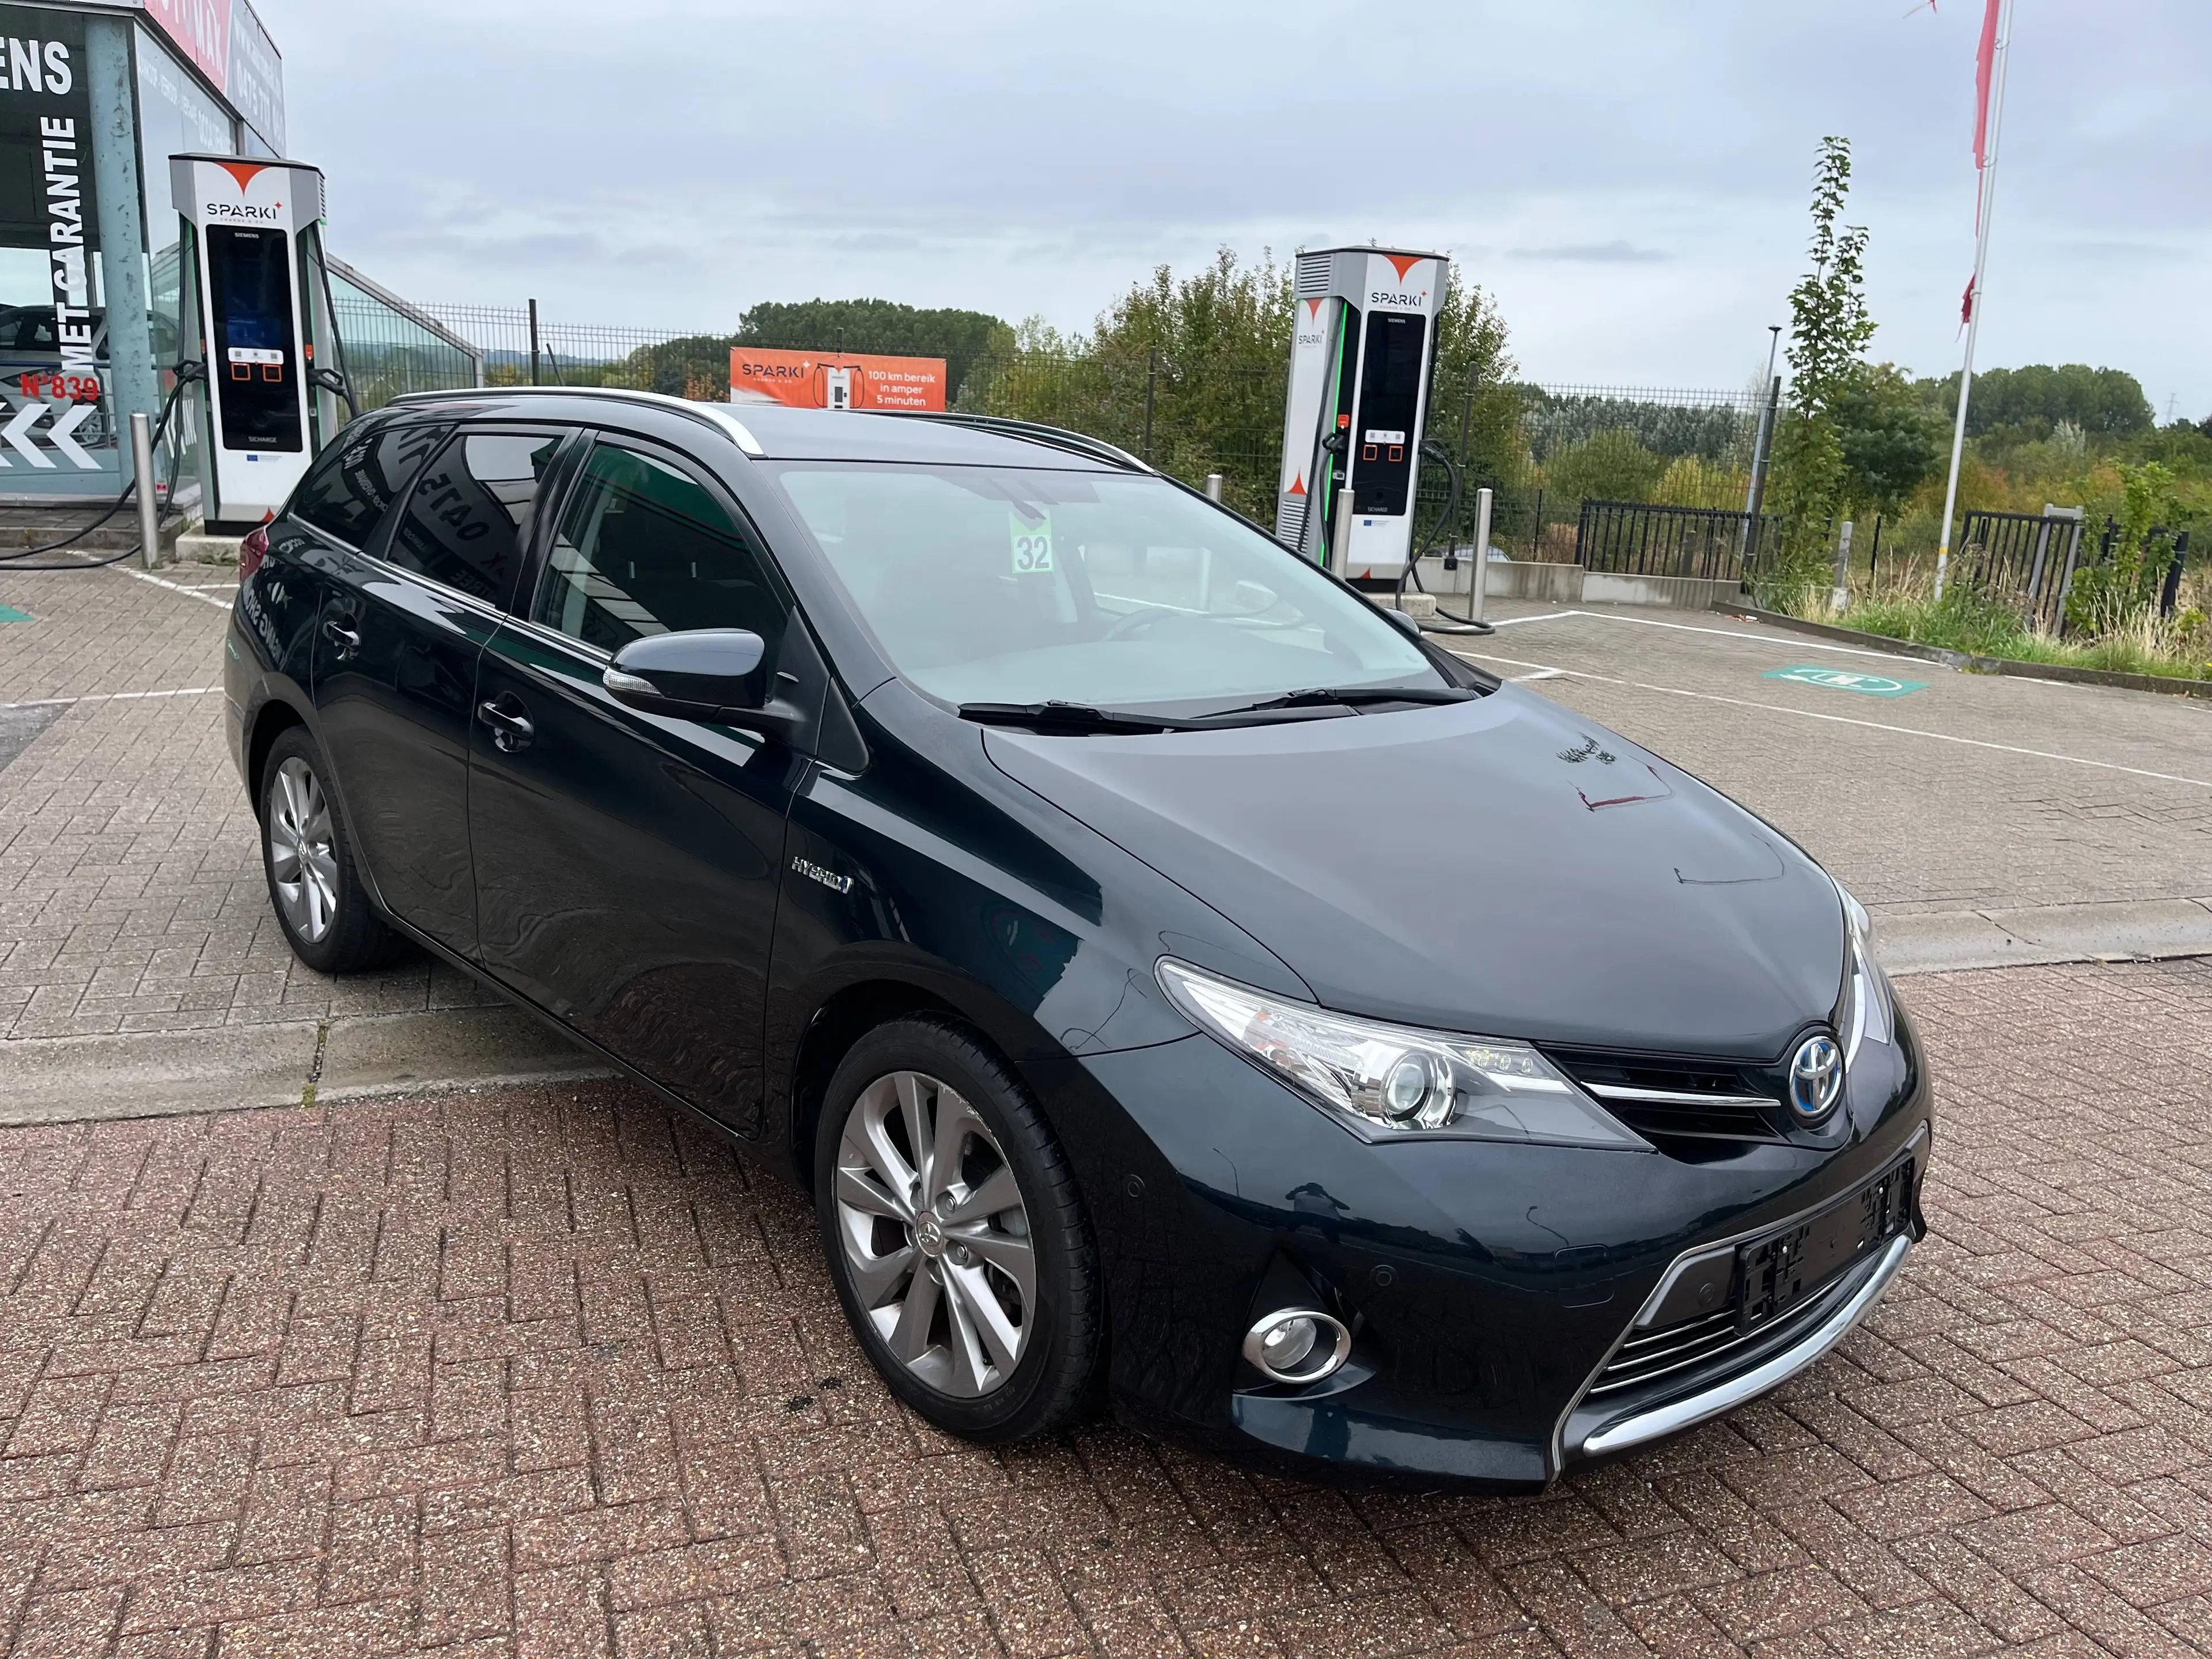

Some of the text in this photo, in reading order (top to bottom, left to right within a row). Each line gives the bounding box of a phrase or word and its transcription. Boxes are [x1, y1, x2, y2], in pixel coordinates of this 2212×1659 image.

[0, 36, 73, 95] NS
[207, 203, 276, 219] SPARKI
[40, 116, 94, 371] MET GARANTIE
[1372, 292, 1422, 306] SPARKI
[742, 363, 804, 378] SPARKI
[868, 370, 936, 383] 100 km bereik
[880, 383, 923, 396] in amper
[877, 395, 926, 406] 5 minuten
[1017, 535, 1050, 570] 32
[791, 856, 845, 892] HYBRID
